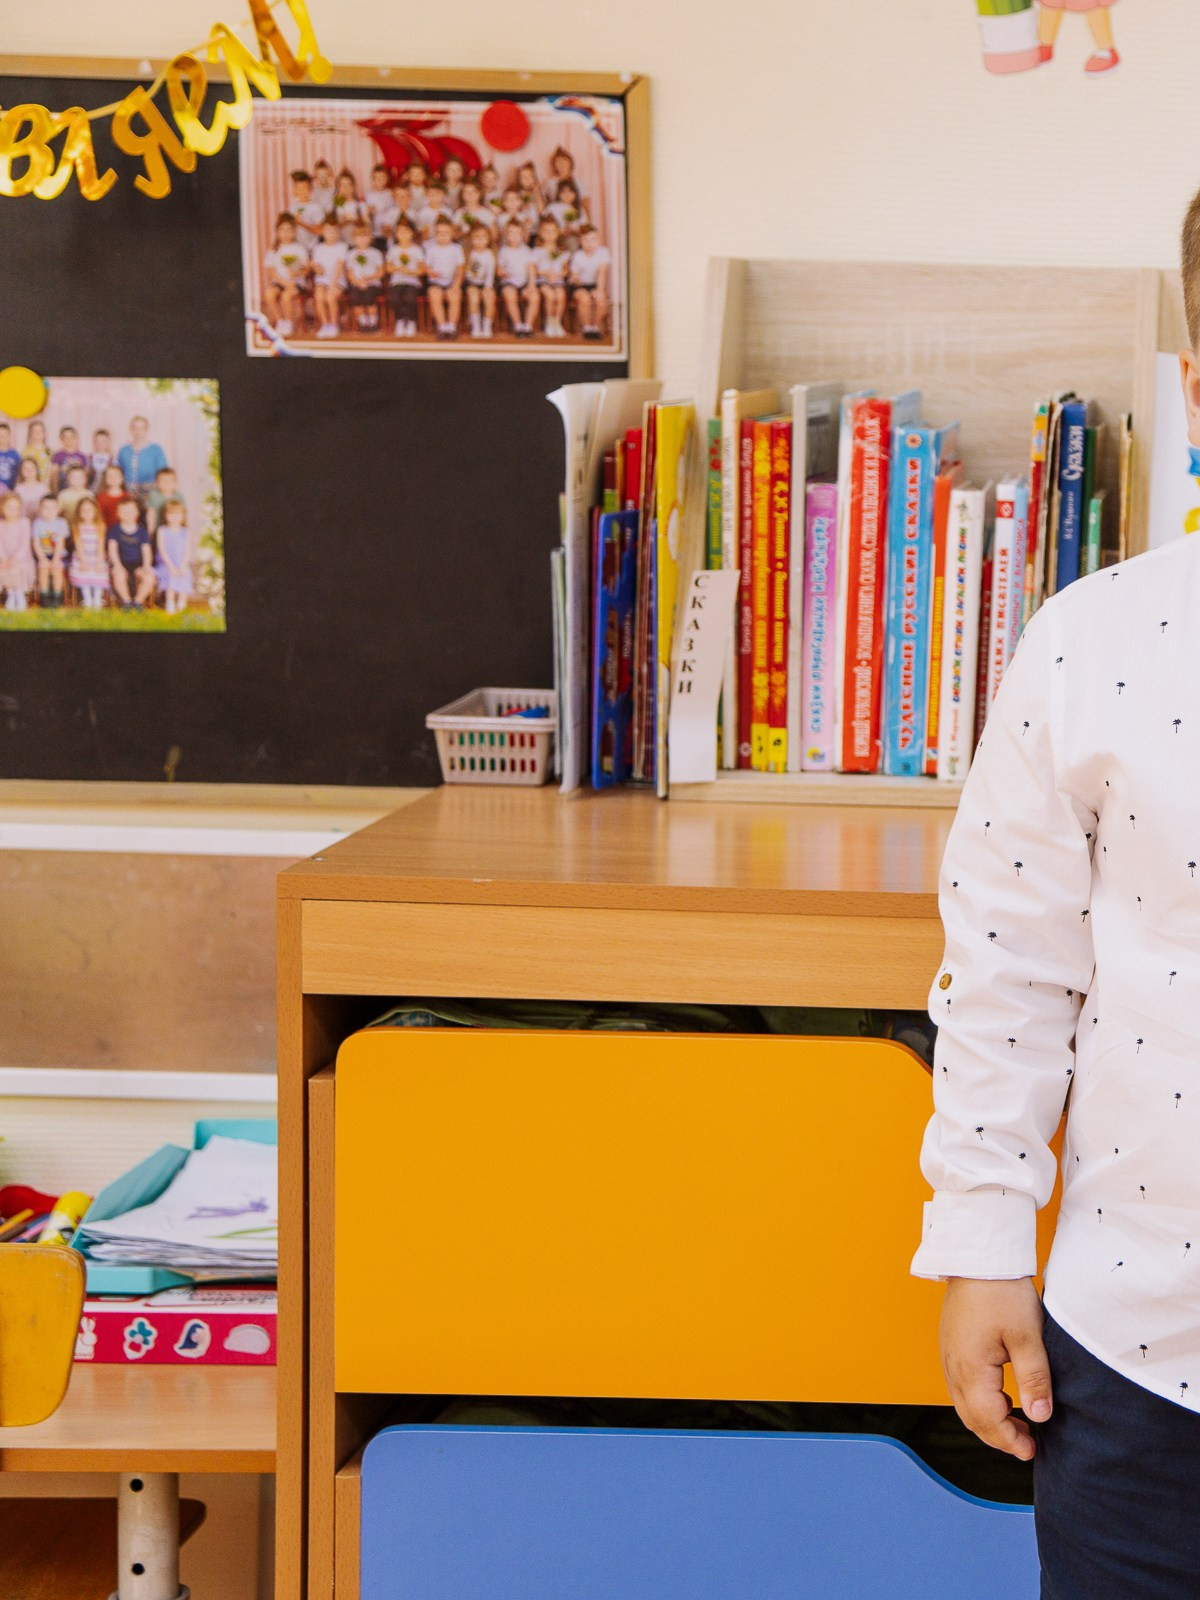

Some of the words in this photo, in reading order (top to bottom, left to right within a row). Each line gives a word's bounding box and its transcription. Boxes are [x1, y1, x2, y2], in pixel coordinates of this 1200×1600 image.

[1061, 425, 1085, 481] Сказки
[904, 458, 920, 540] СКАЗКИ
[902, 547, 918, 635] РУССКИЕ
[996, 547, 1009, 630] ПИСАТЕЛЕЙ
[675, 574, 711, 697] СКАЗКИ
[898, 641, 917, 749] ЧУДЕСНЫЕ
